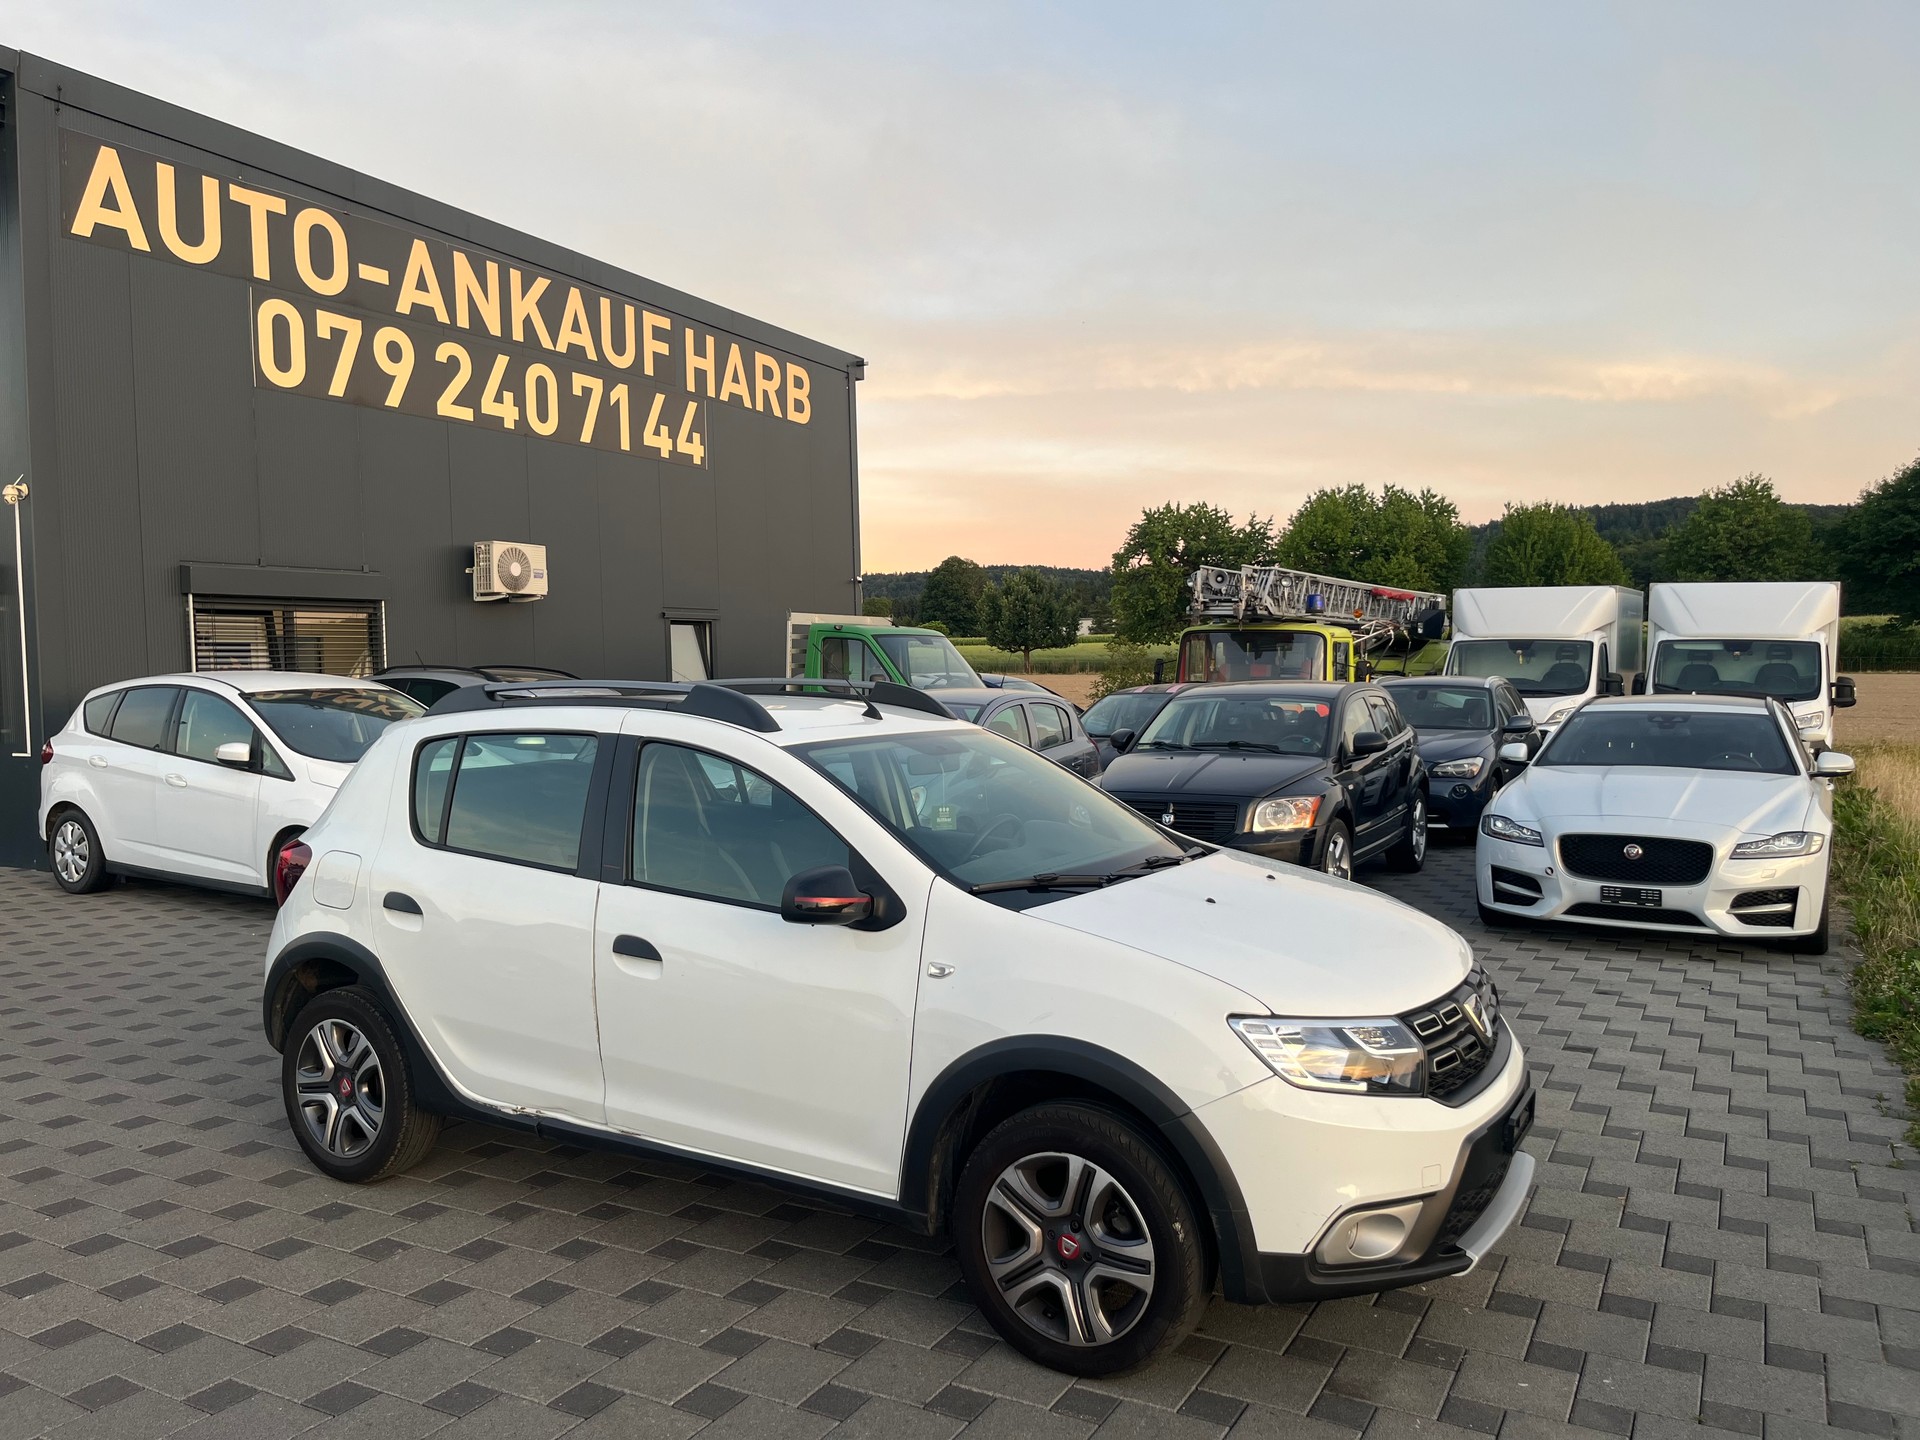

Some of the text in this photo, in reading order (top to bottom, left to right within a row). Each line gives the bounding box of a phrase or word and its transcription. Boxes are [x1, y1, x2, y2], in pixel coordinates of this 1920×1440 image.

[72, 146, 812, 425] AUTO-ANKAUF HARB
[258, 299, 705, 465] 079 240 71 44
